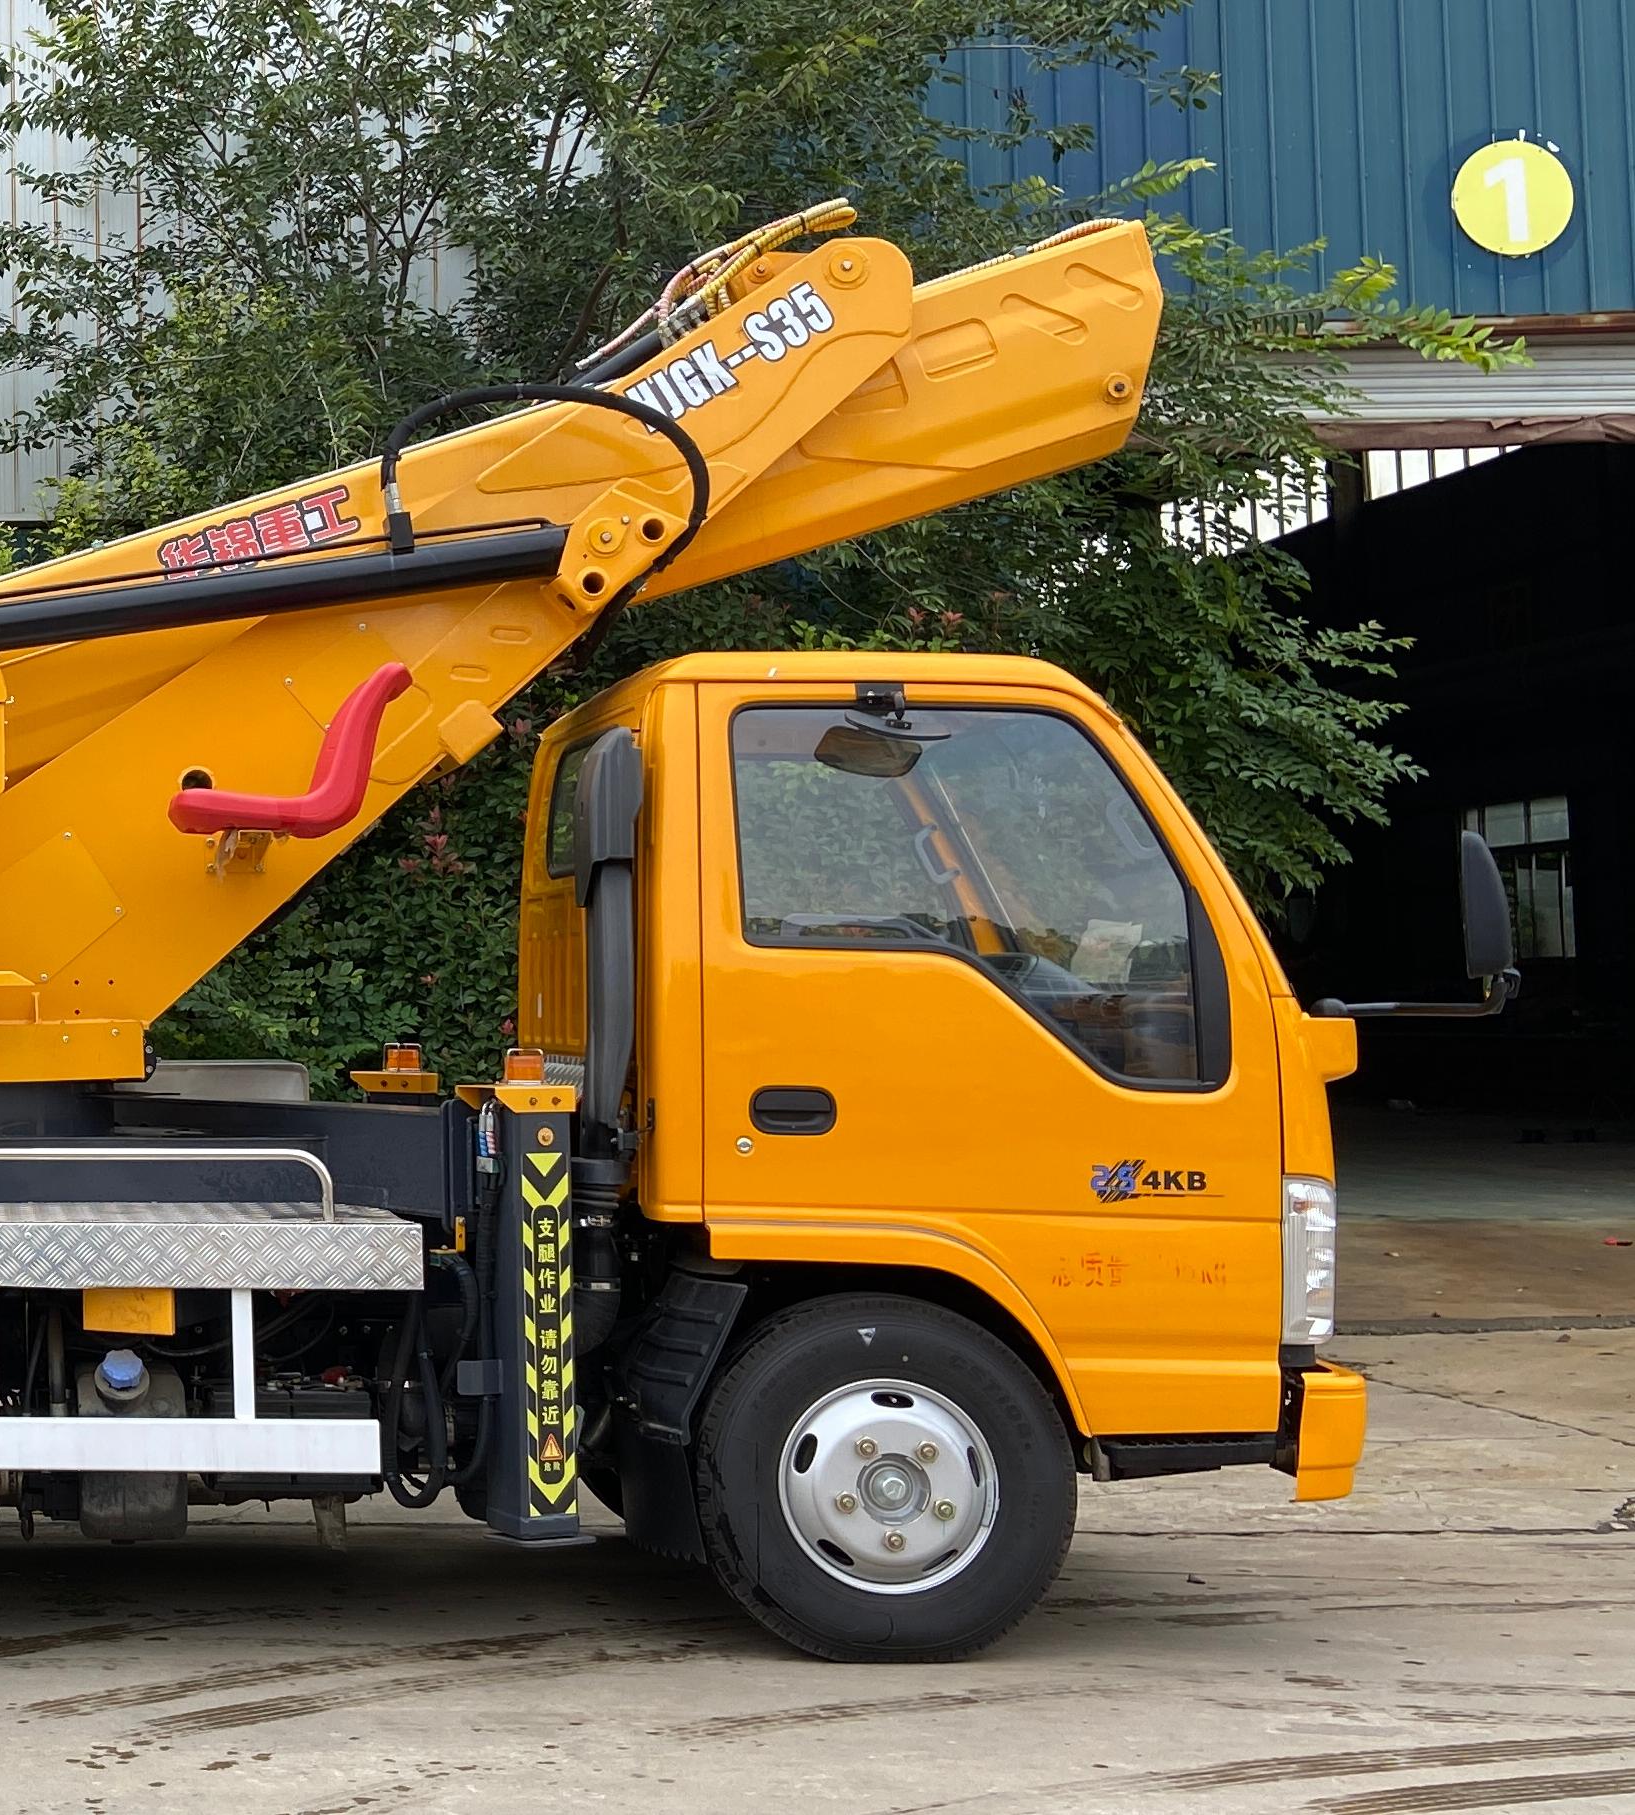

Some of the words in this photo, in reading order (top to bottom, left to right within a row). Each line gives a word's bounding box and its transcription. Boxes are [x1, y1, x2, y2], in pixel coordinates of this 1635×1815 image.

[1482, 157, 1530, 243] 1
[1142, 1170, 1207, 1191] 4KB
[537, 1217, 557, 1315] 支腿作业
[539, 1328, 560, 1426] 请勿靠近
